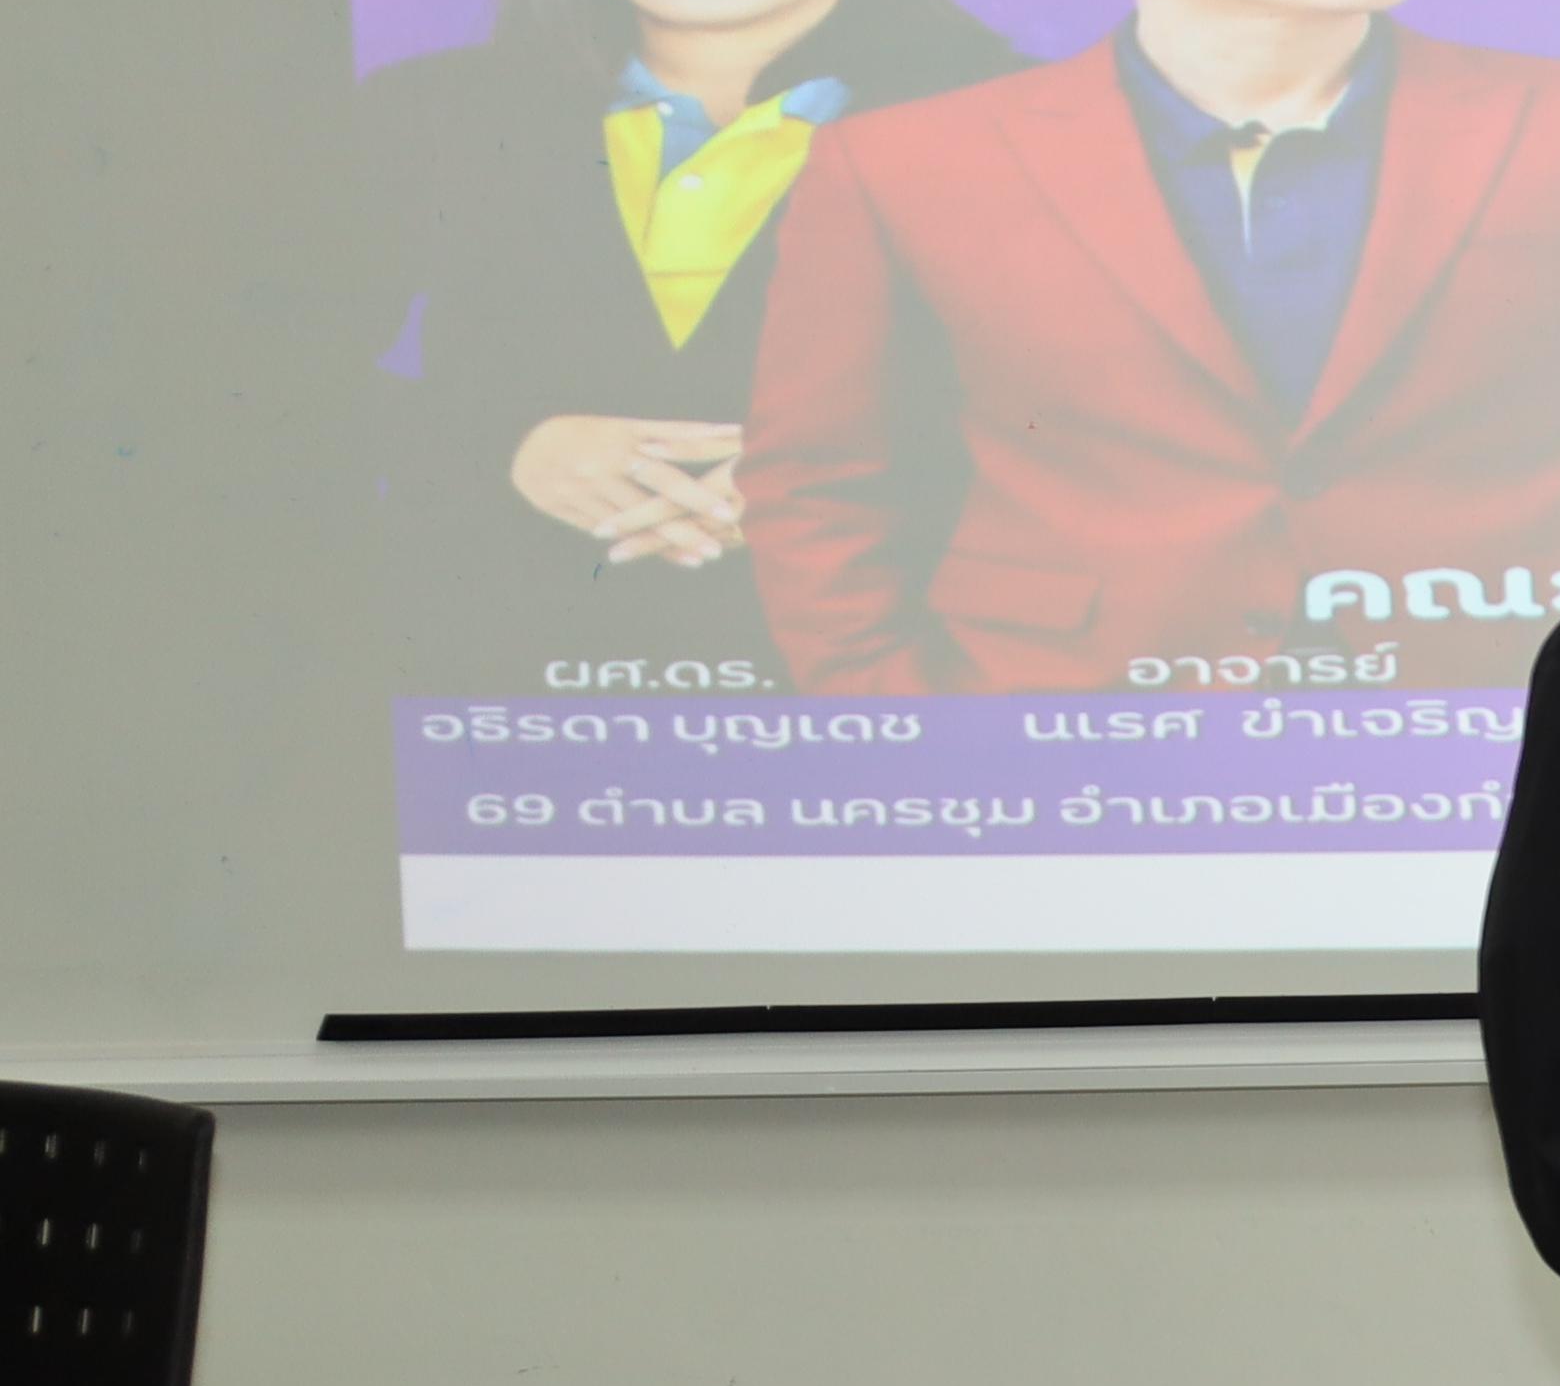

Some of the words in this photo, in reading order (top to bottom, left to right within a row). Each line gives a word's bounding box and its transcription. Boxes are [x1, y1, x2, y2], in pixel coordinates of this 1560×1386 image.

[545, 658, 775, 690] ผศ.ดร.
[1127, 641, 1400, 686] อาจารย์
[672, 711, 923, 755] บุญเดช
[1022, 706, 1206, 742] นเรศ
[1240, 697, 1526, 743] ขำเจริญ
[466, 794, 556, 827] 69
[577, 785, 766, 828] ตำบล
[790, 795, 1037, 838] นครชุม
